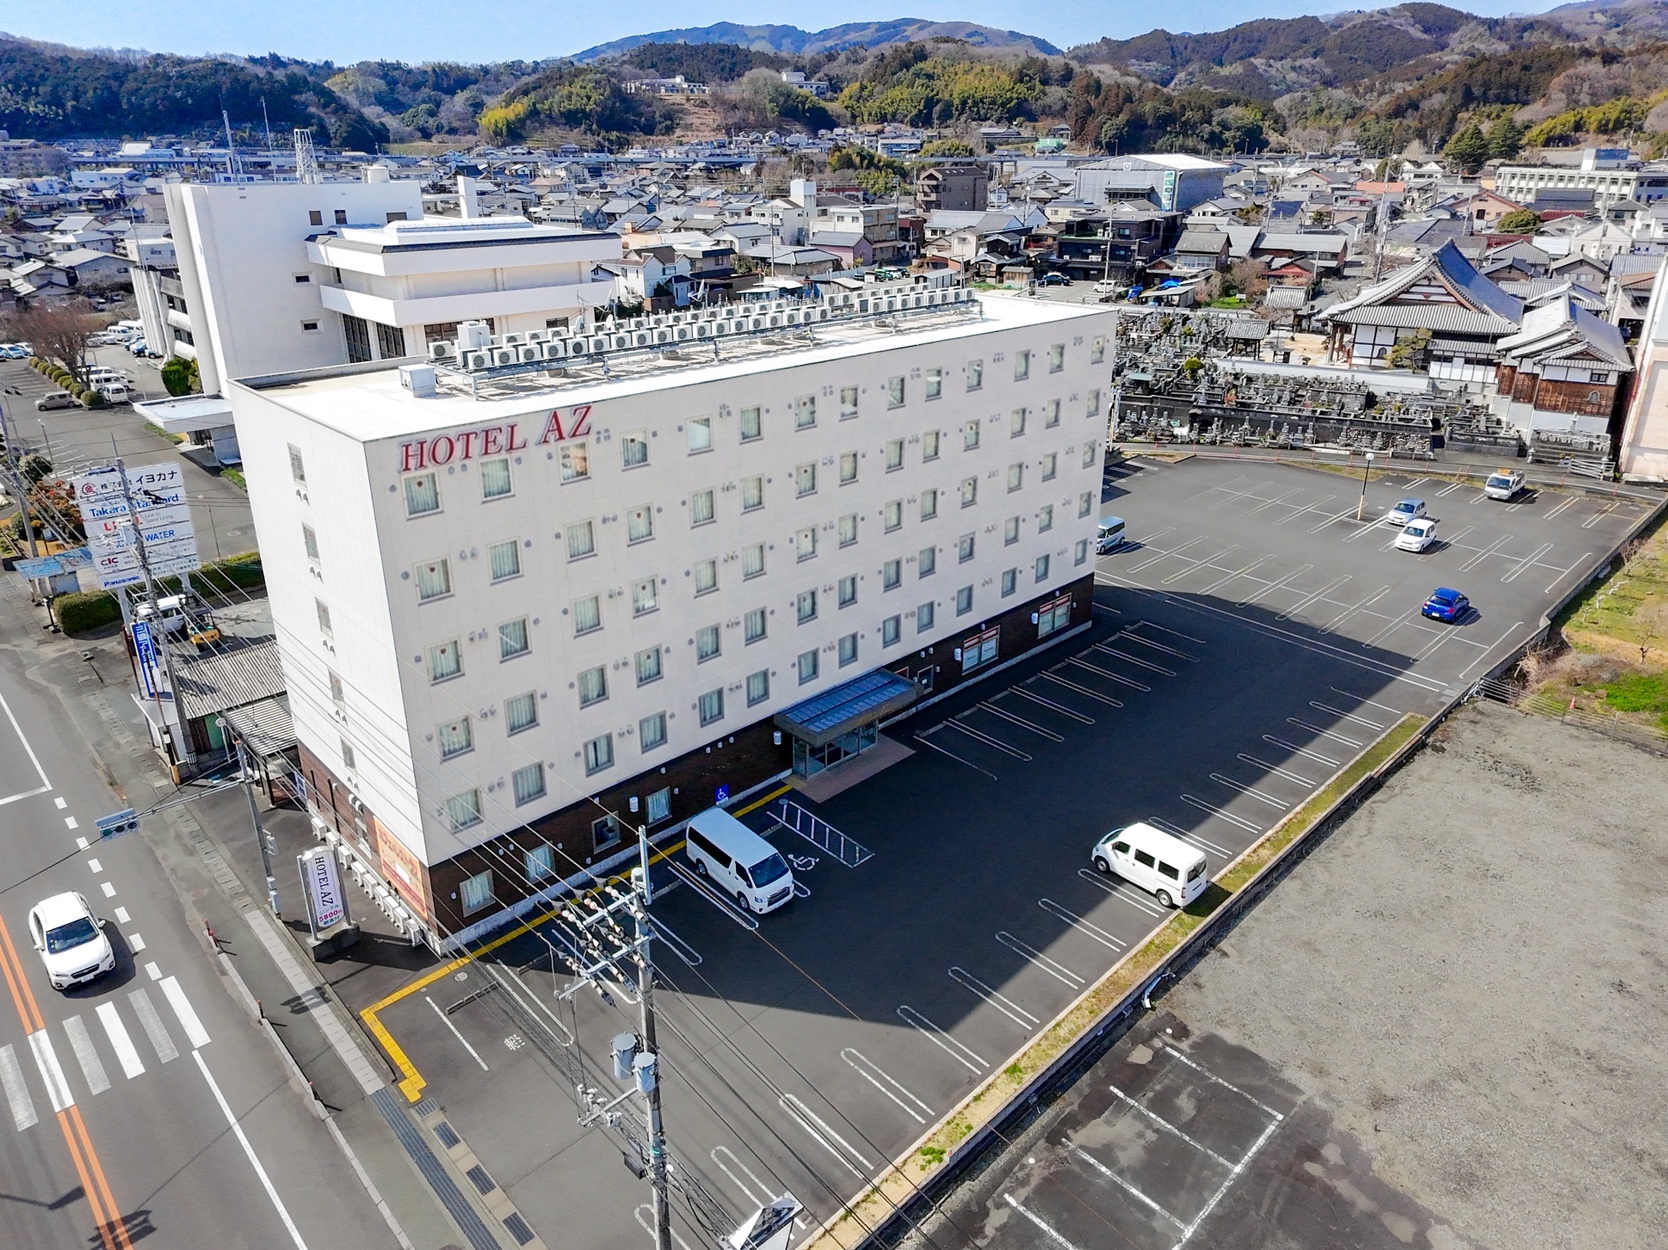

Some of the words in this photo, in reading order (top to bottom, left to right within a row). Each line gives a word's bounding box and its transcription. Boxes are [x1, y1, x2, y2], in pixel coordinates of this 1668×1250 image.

[400, 423, 527, 472] HOTEL
[539, 405, 593, 445] AZ
[136, 470, 178, 485] イヨカナ
[89, 505, 127, 517] Takara
[145, 529, 175, 542] WATER
[104, 575, 140, 587] Panasonic
[314, 856, 329, 890] HOTEL
[320, 891, 334, 907] AZ
